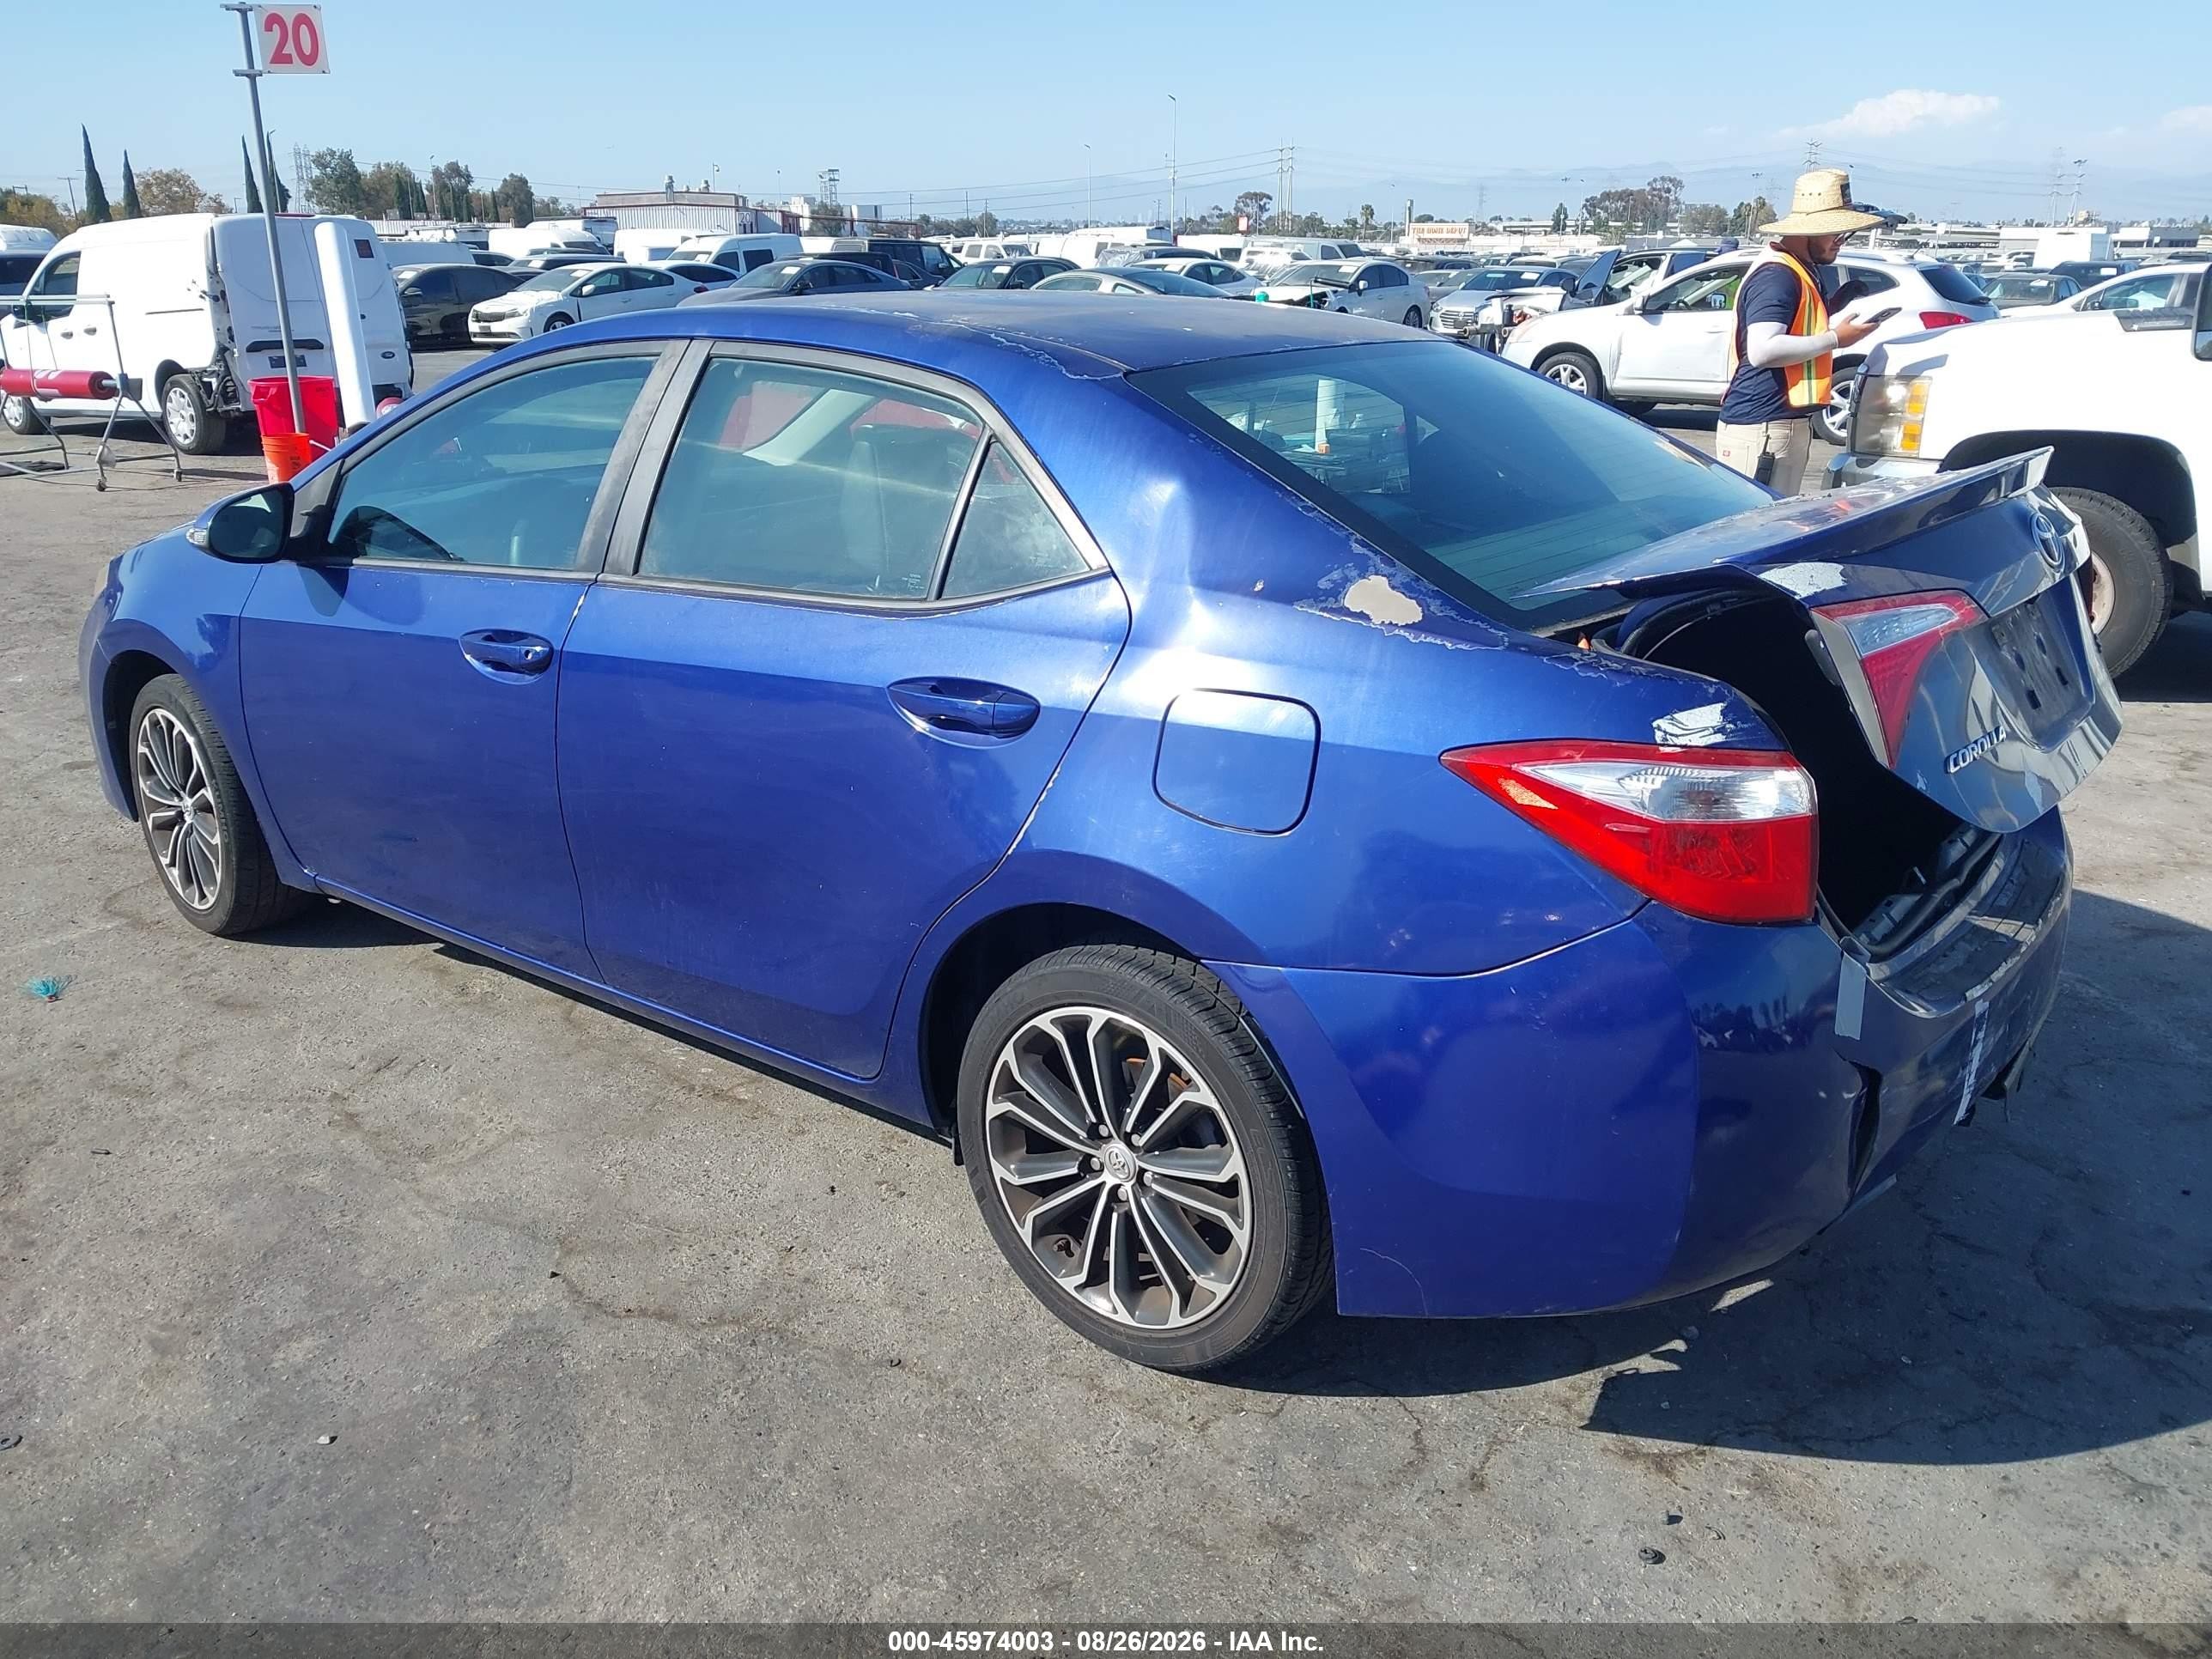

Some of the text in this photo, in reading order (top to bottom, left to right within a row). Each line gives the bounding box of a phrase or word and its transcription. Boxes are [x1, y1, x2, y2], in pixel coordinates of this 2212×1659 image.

[264, 12, 319, 67] 20
[740, 212, 750, 223] 20
[1948, 726, 2007, 774] COROLLA
